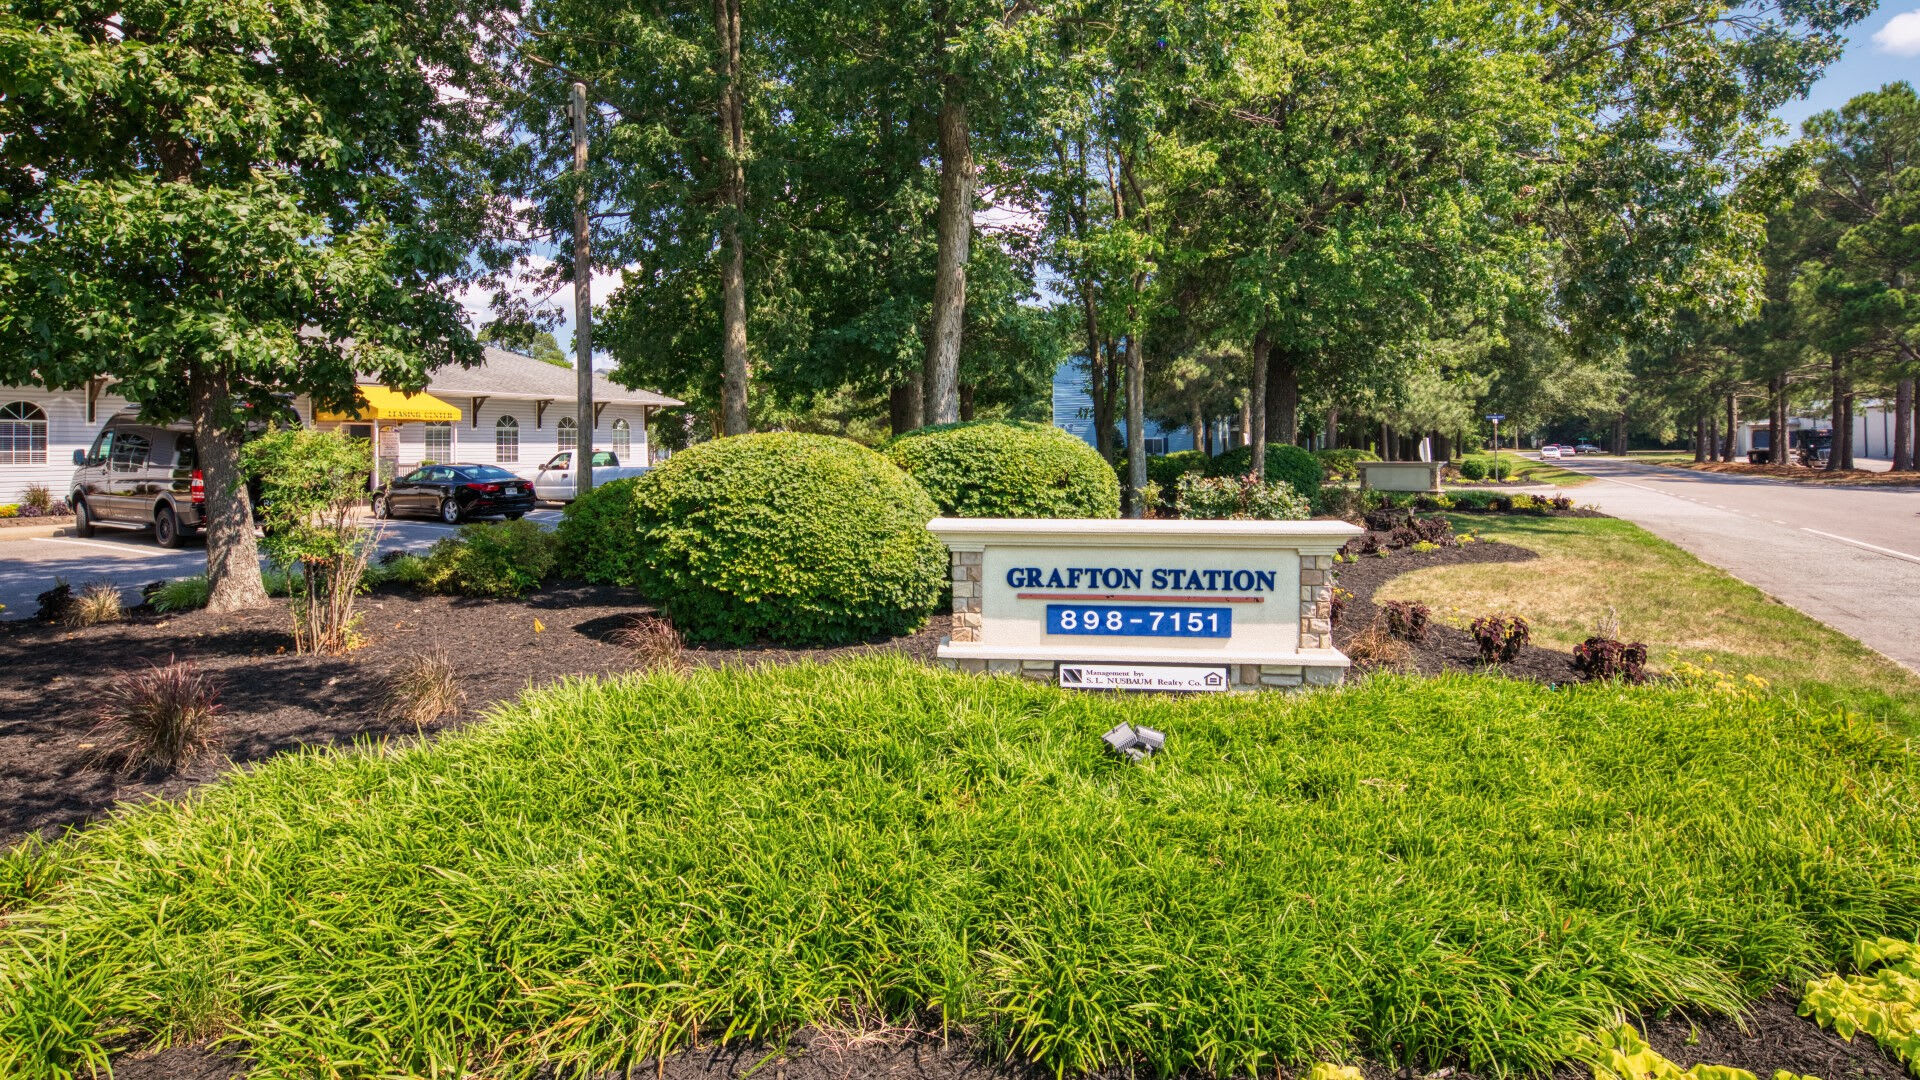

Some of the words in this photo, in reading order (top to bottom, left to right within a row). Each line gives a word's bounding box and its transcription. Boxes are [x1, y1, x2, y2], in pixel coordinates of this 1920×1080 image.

[388, 410, 421, 418] LEASING
[424, 411, 453, 419] CENTER
[1006, 567, 1143, 589] GRAFTON
[1151, 568, 1277, 592] STATION
[1060, 609, 1218, 632] 898-7151
[1086, 669, 1129, 677] Management
[1133, 670, 1144, 678] by:
[1107, 677, 1153, 686] NUSBAUM
[1157, 678, 1184, 688] Realty
[1188, 679, 1202, 687] Co.
